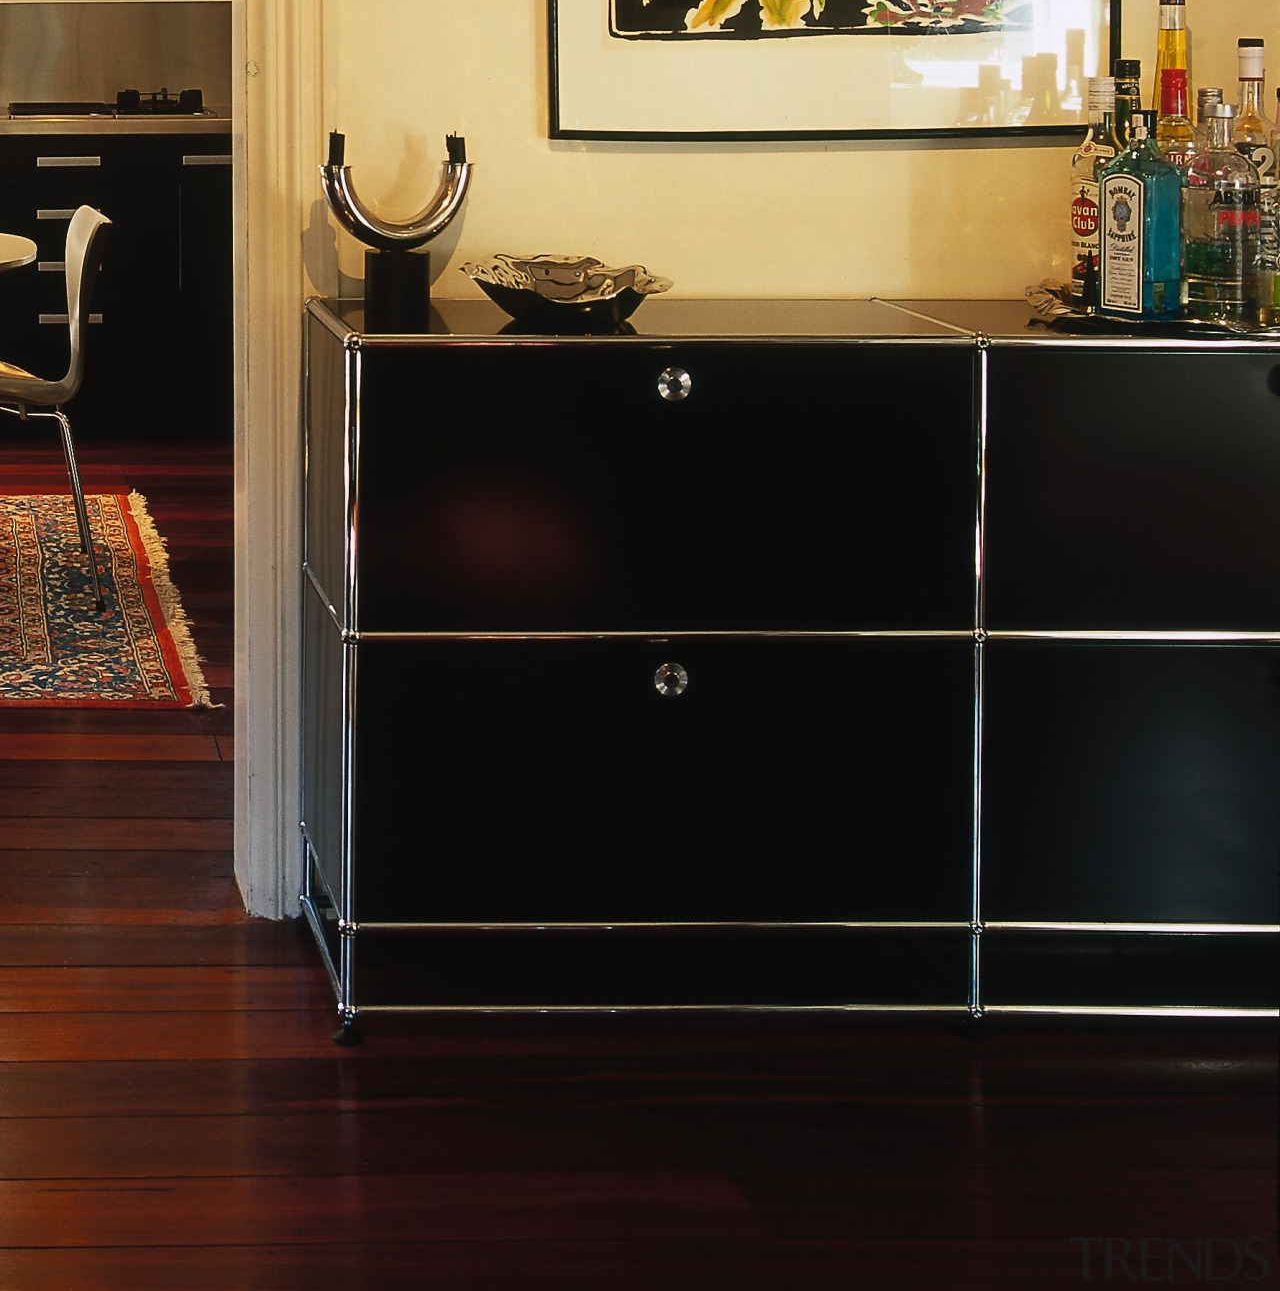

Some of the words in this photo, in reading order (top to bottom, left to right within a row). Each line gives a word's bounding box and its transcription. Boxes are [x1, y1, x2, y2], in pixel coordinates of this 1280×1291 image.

[1108, 186, 1136, 201] BOMBAY
[1073, 217, 1095, 230] Club
[1107, 228, 1137, 243] SAPPHIRE
